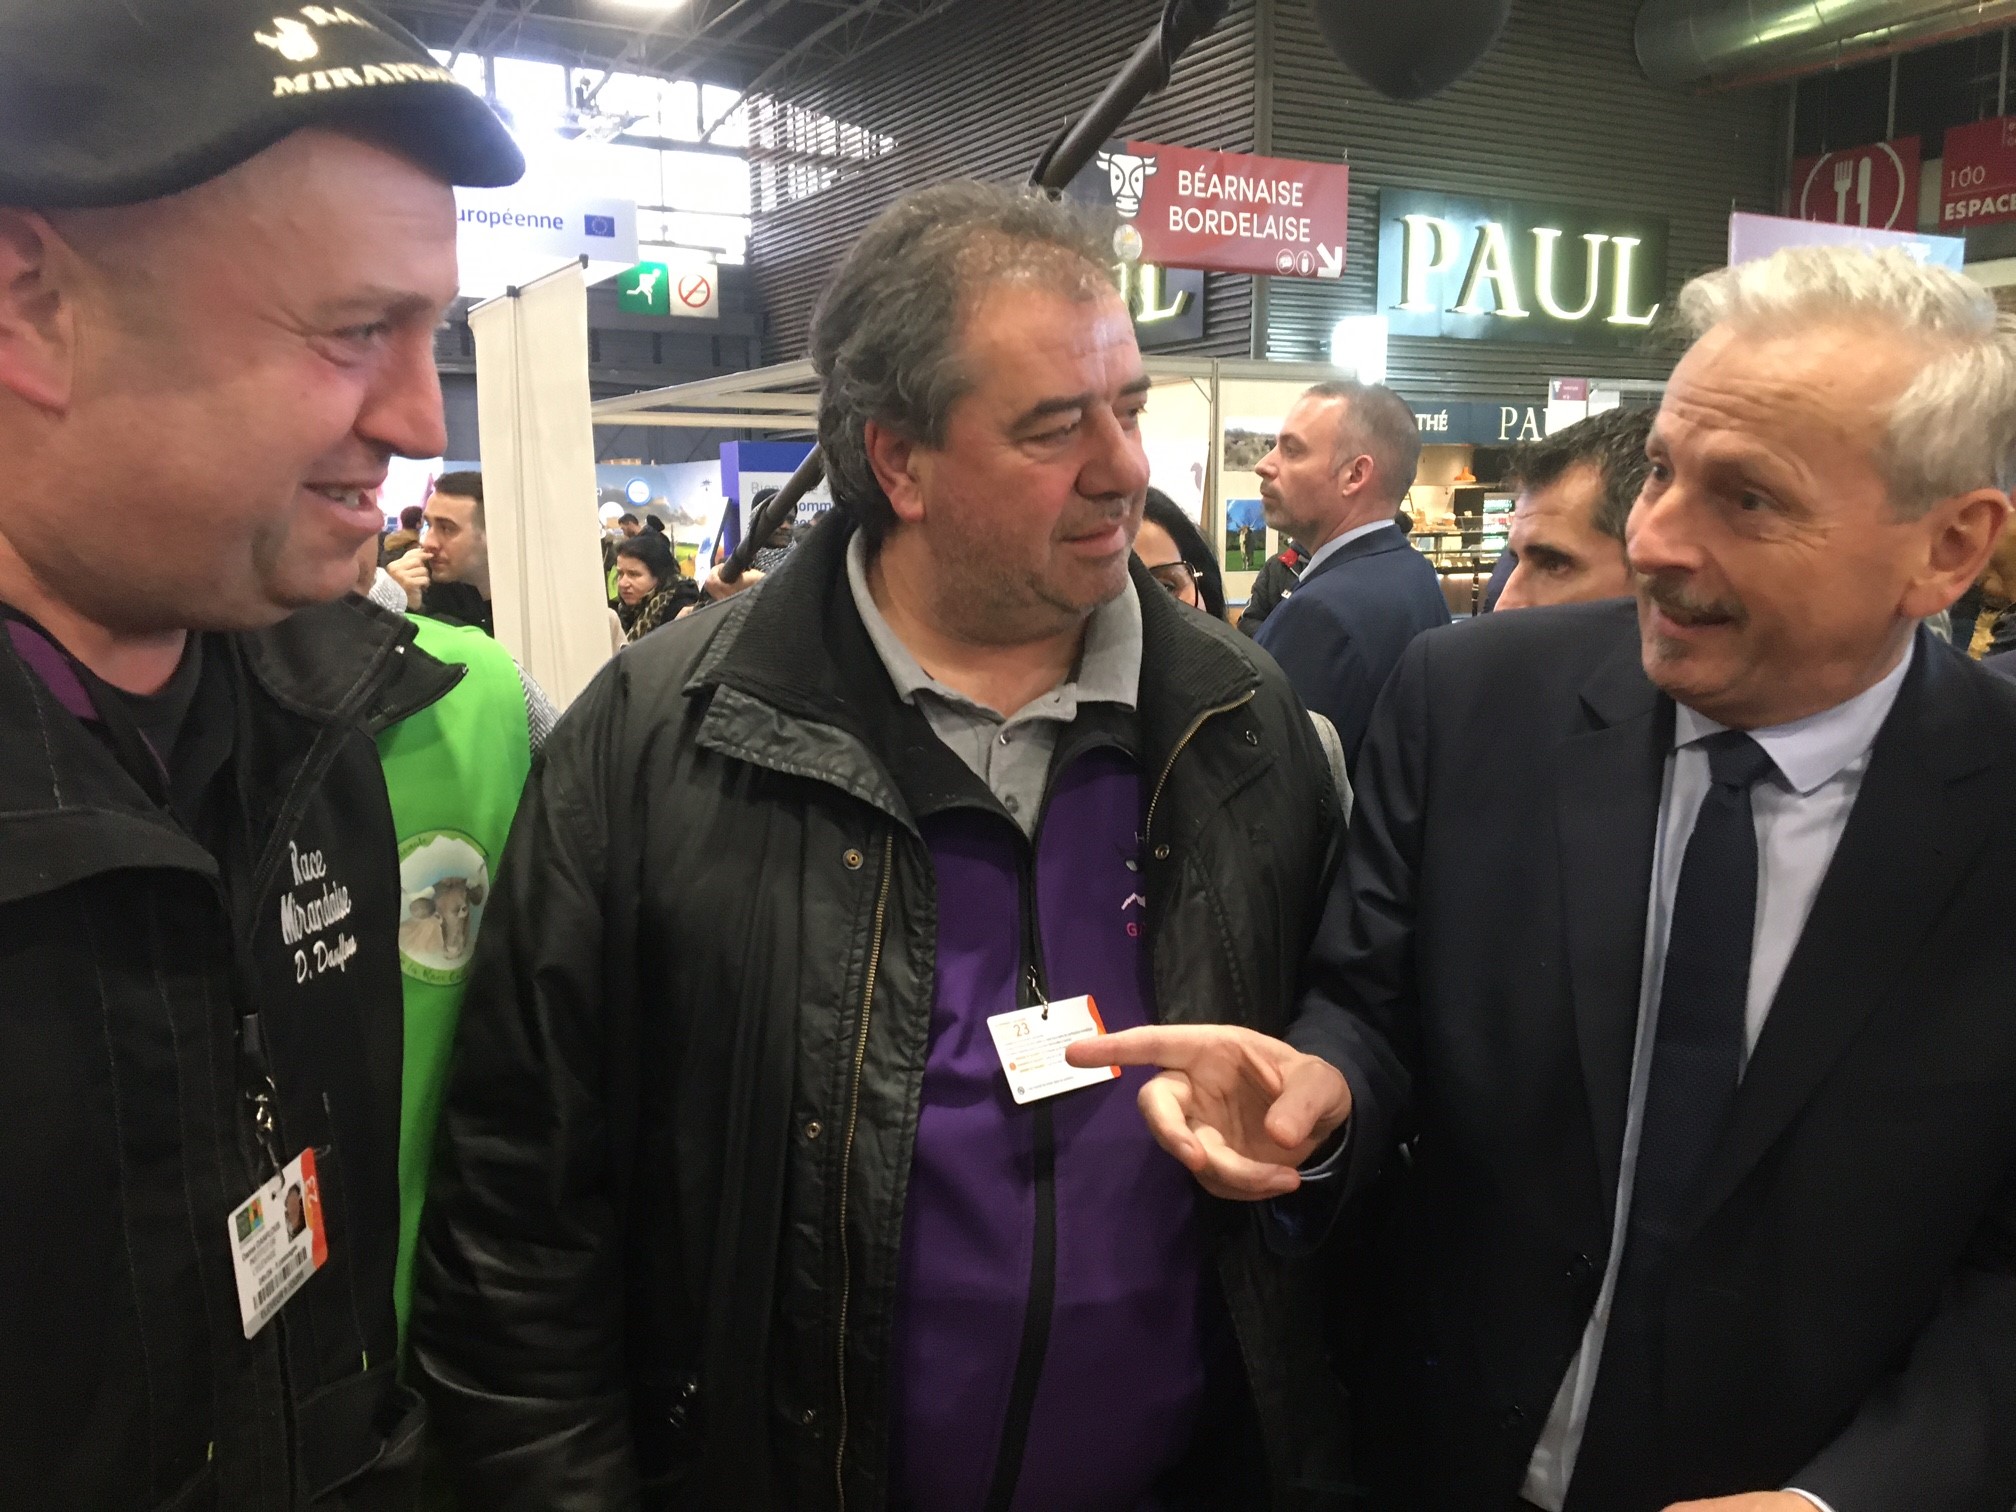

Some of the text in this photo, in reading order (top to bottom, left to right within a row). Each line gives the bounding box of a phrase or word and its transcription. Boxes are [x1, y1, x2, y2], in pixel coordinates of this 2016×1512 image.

[1178, 165, 1304, 207] BÉARNAISE
[1950, 165, 1986, 188] 100
[456, 208, 564, 231] uropéenne
[1169, 205, 1311, 243] BORDELAISE
[1390, 214, 1660, 325] PAUL
[1415, 409, 1449, 431] THÉ
[289, 840, 326, 886] Race
[1013, 1022, 1030, 1037] 23
